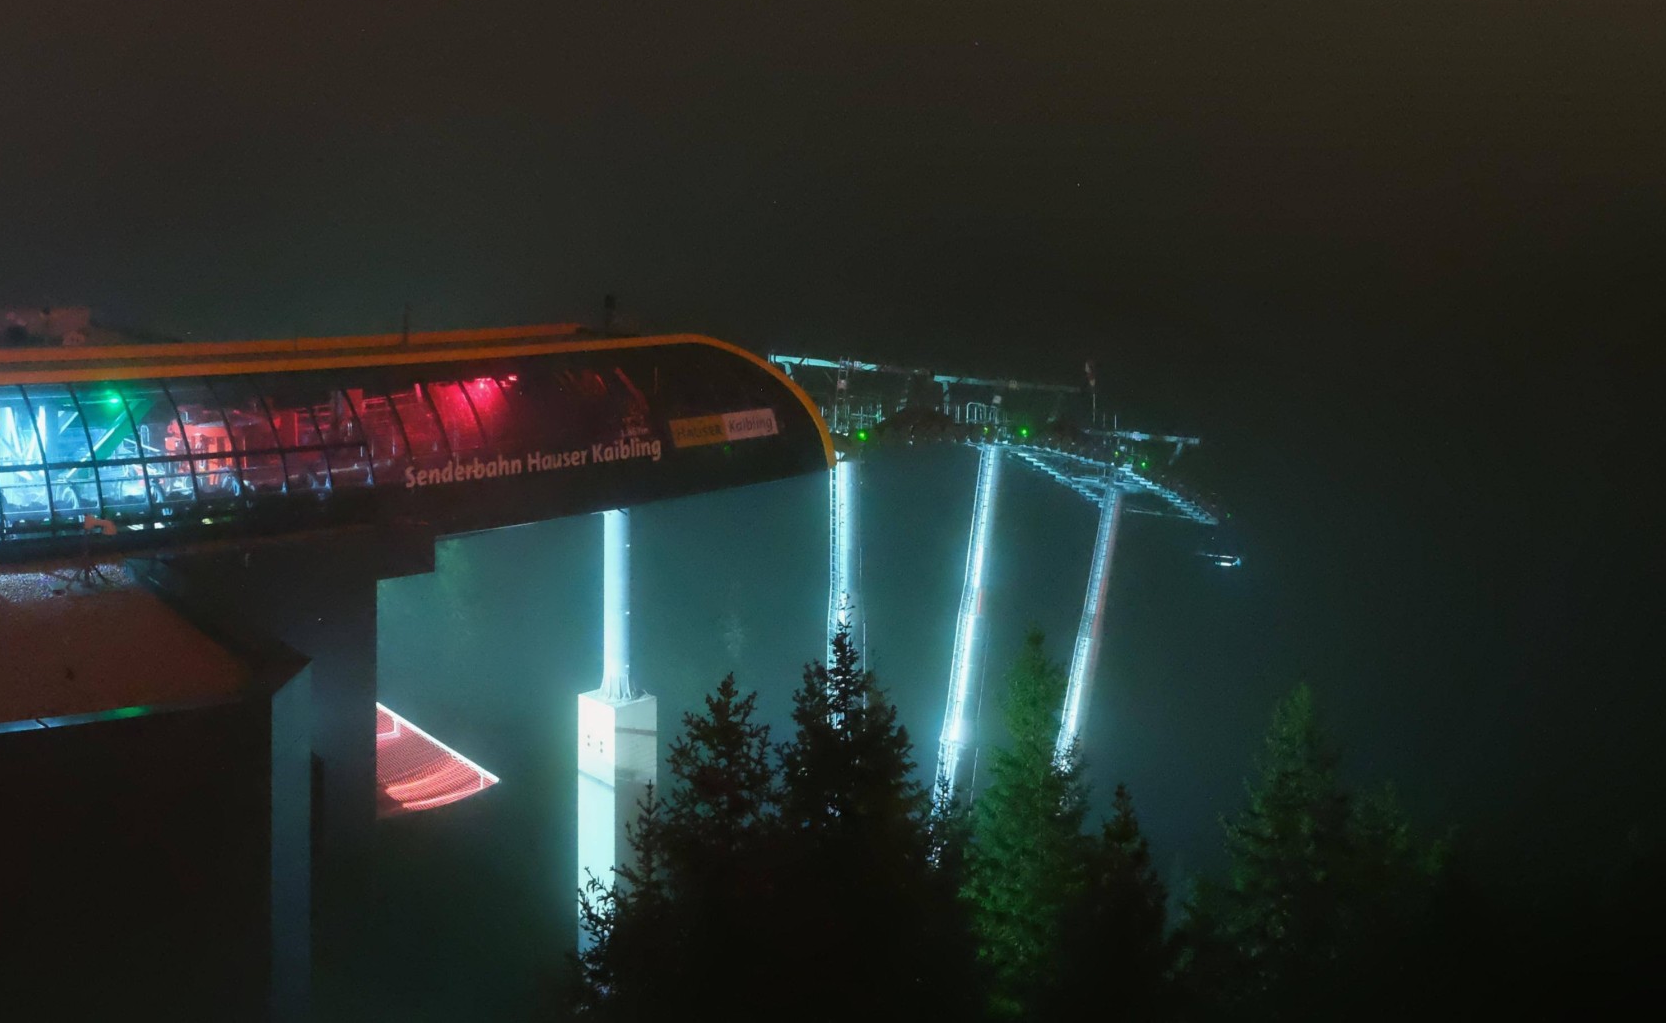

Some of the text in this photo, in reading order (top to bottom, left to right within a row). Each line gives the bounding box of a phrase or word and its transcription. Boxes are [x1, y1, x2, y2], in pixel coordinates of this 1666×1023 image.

[728, 417, 773, 433] Kaibling
[405, 438, 662, 489] Senderbahn Hauser Kaibling
